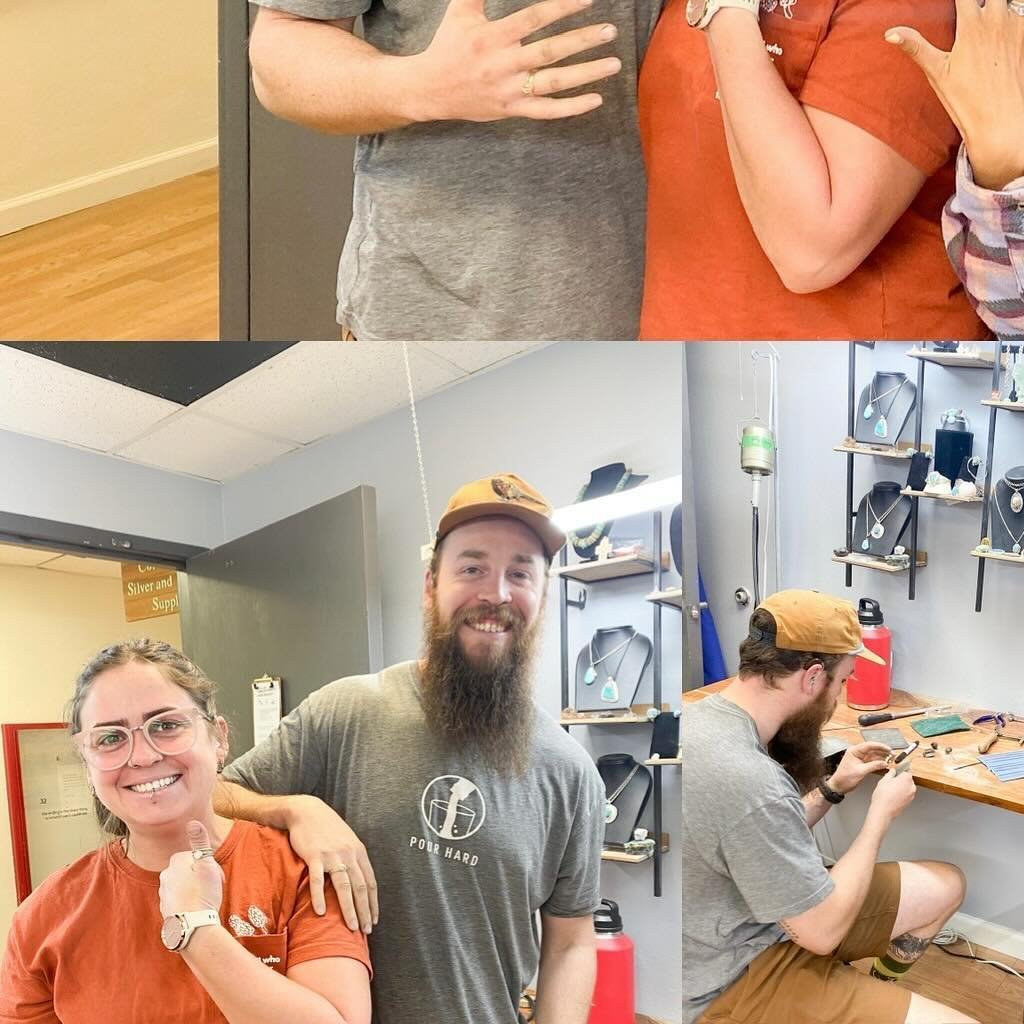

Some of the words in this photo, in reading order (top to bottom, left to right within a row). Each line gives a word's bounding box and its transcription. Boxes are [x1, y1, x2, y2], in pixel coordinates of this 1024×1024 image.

[766, 43, 783, 56] who
[127, 582, 154, 597] Silver
[156, 575, 173, 591] and
[409, 837, 440, 855] POUR
[444, 847, 479, 866] HARD
[262, 954, 281, 964] who
